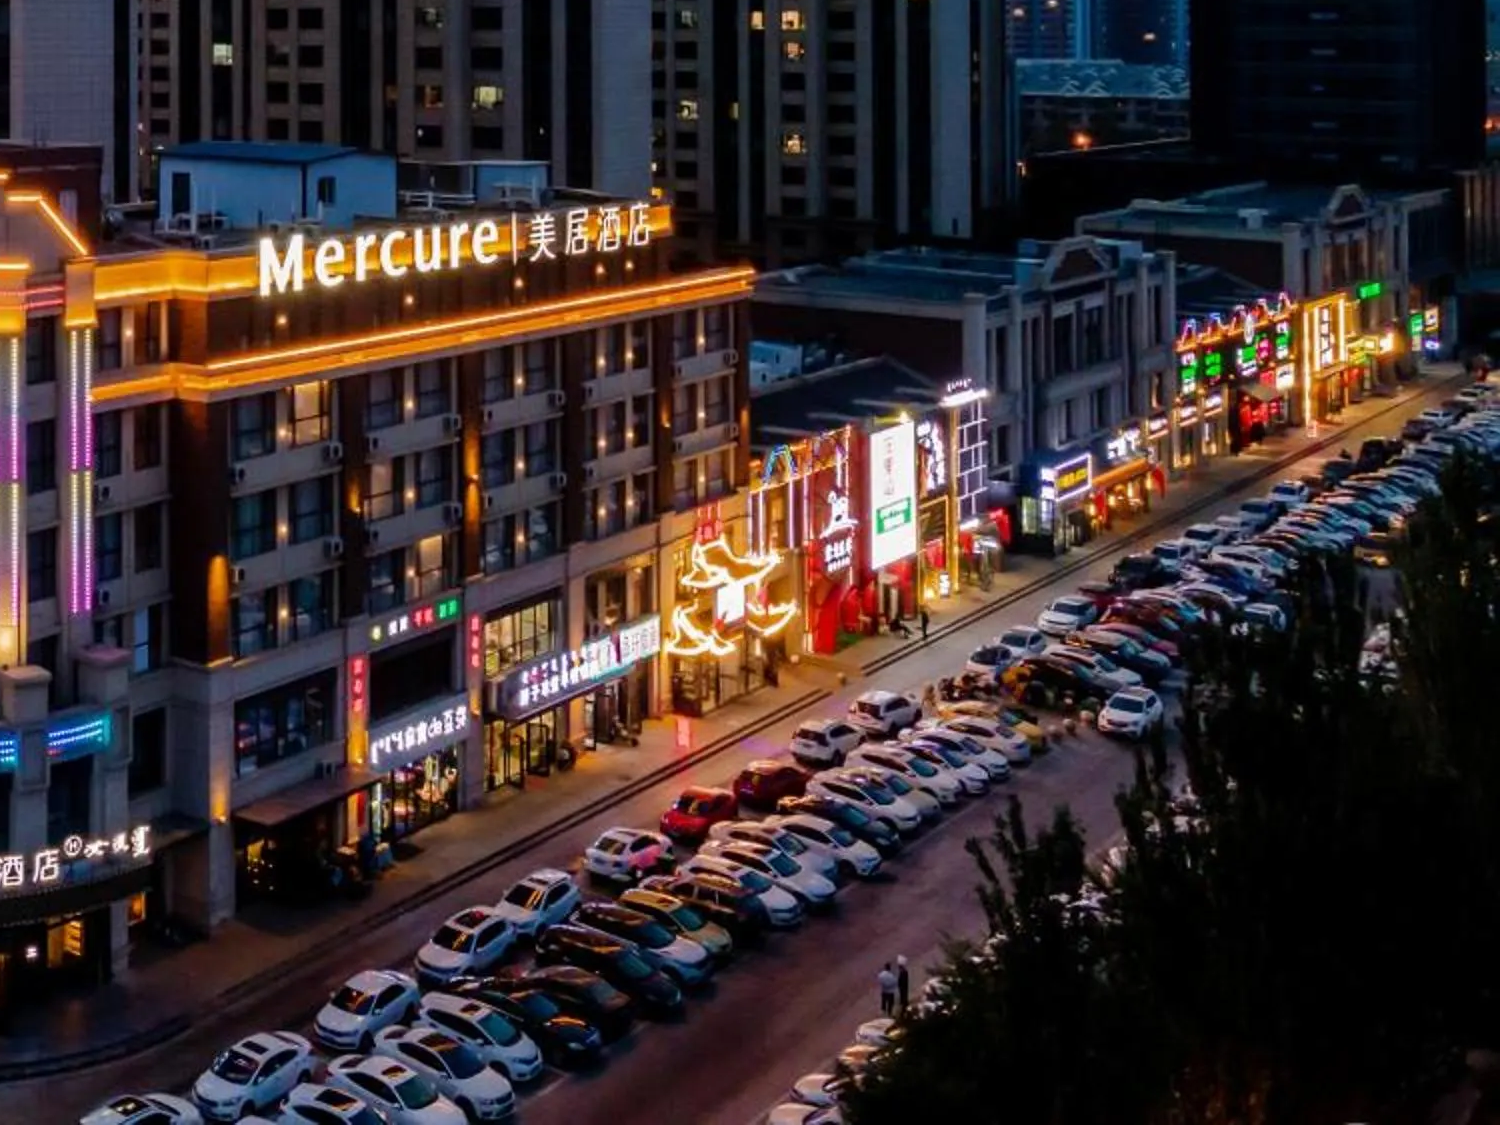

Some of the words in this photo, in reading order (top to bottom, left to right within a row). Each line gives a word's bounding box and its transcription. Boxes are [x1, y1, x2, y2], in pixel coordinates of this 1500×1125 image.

[258, 218, 499, 297] Mercure
[528, 201, 651, 263] 美居酒店
